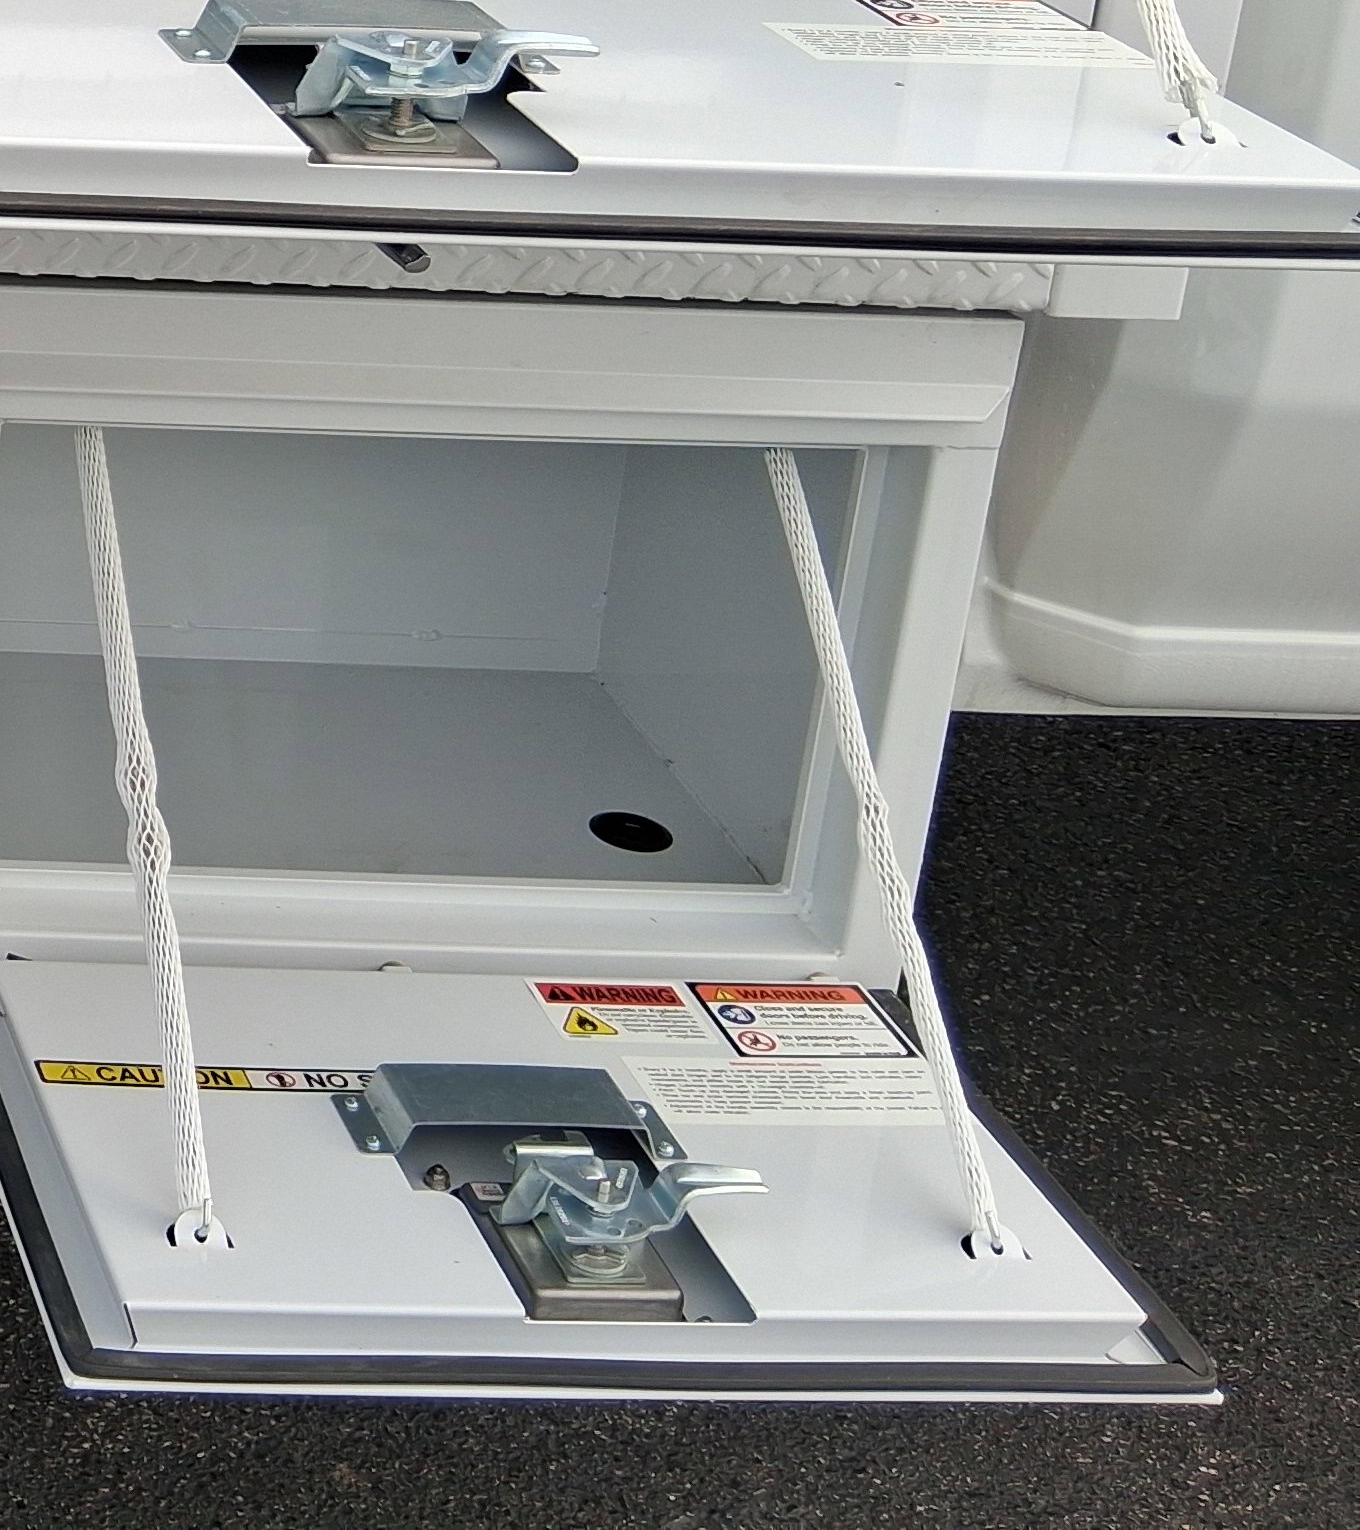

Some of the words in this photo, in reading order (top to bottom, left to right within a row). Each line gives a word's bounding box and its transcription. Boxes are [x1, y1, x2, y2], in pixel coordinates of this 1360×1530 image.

[573, 986, 677, 1004] WARNING
[736, 988, 847, 1001] WARNING
[95, 1066, 233, 1086] CAUON
[303, 1073, 349, 1089] NO
